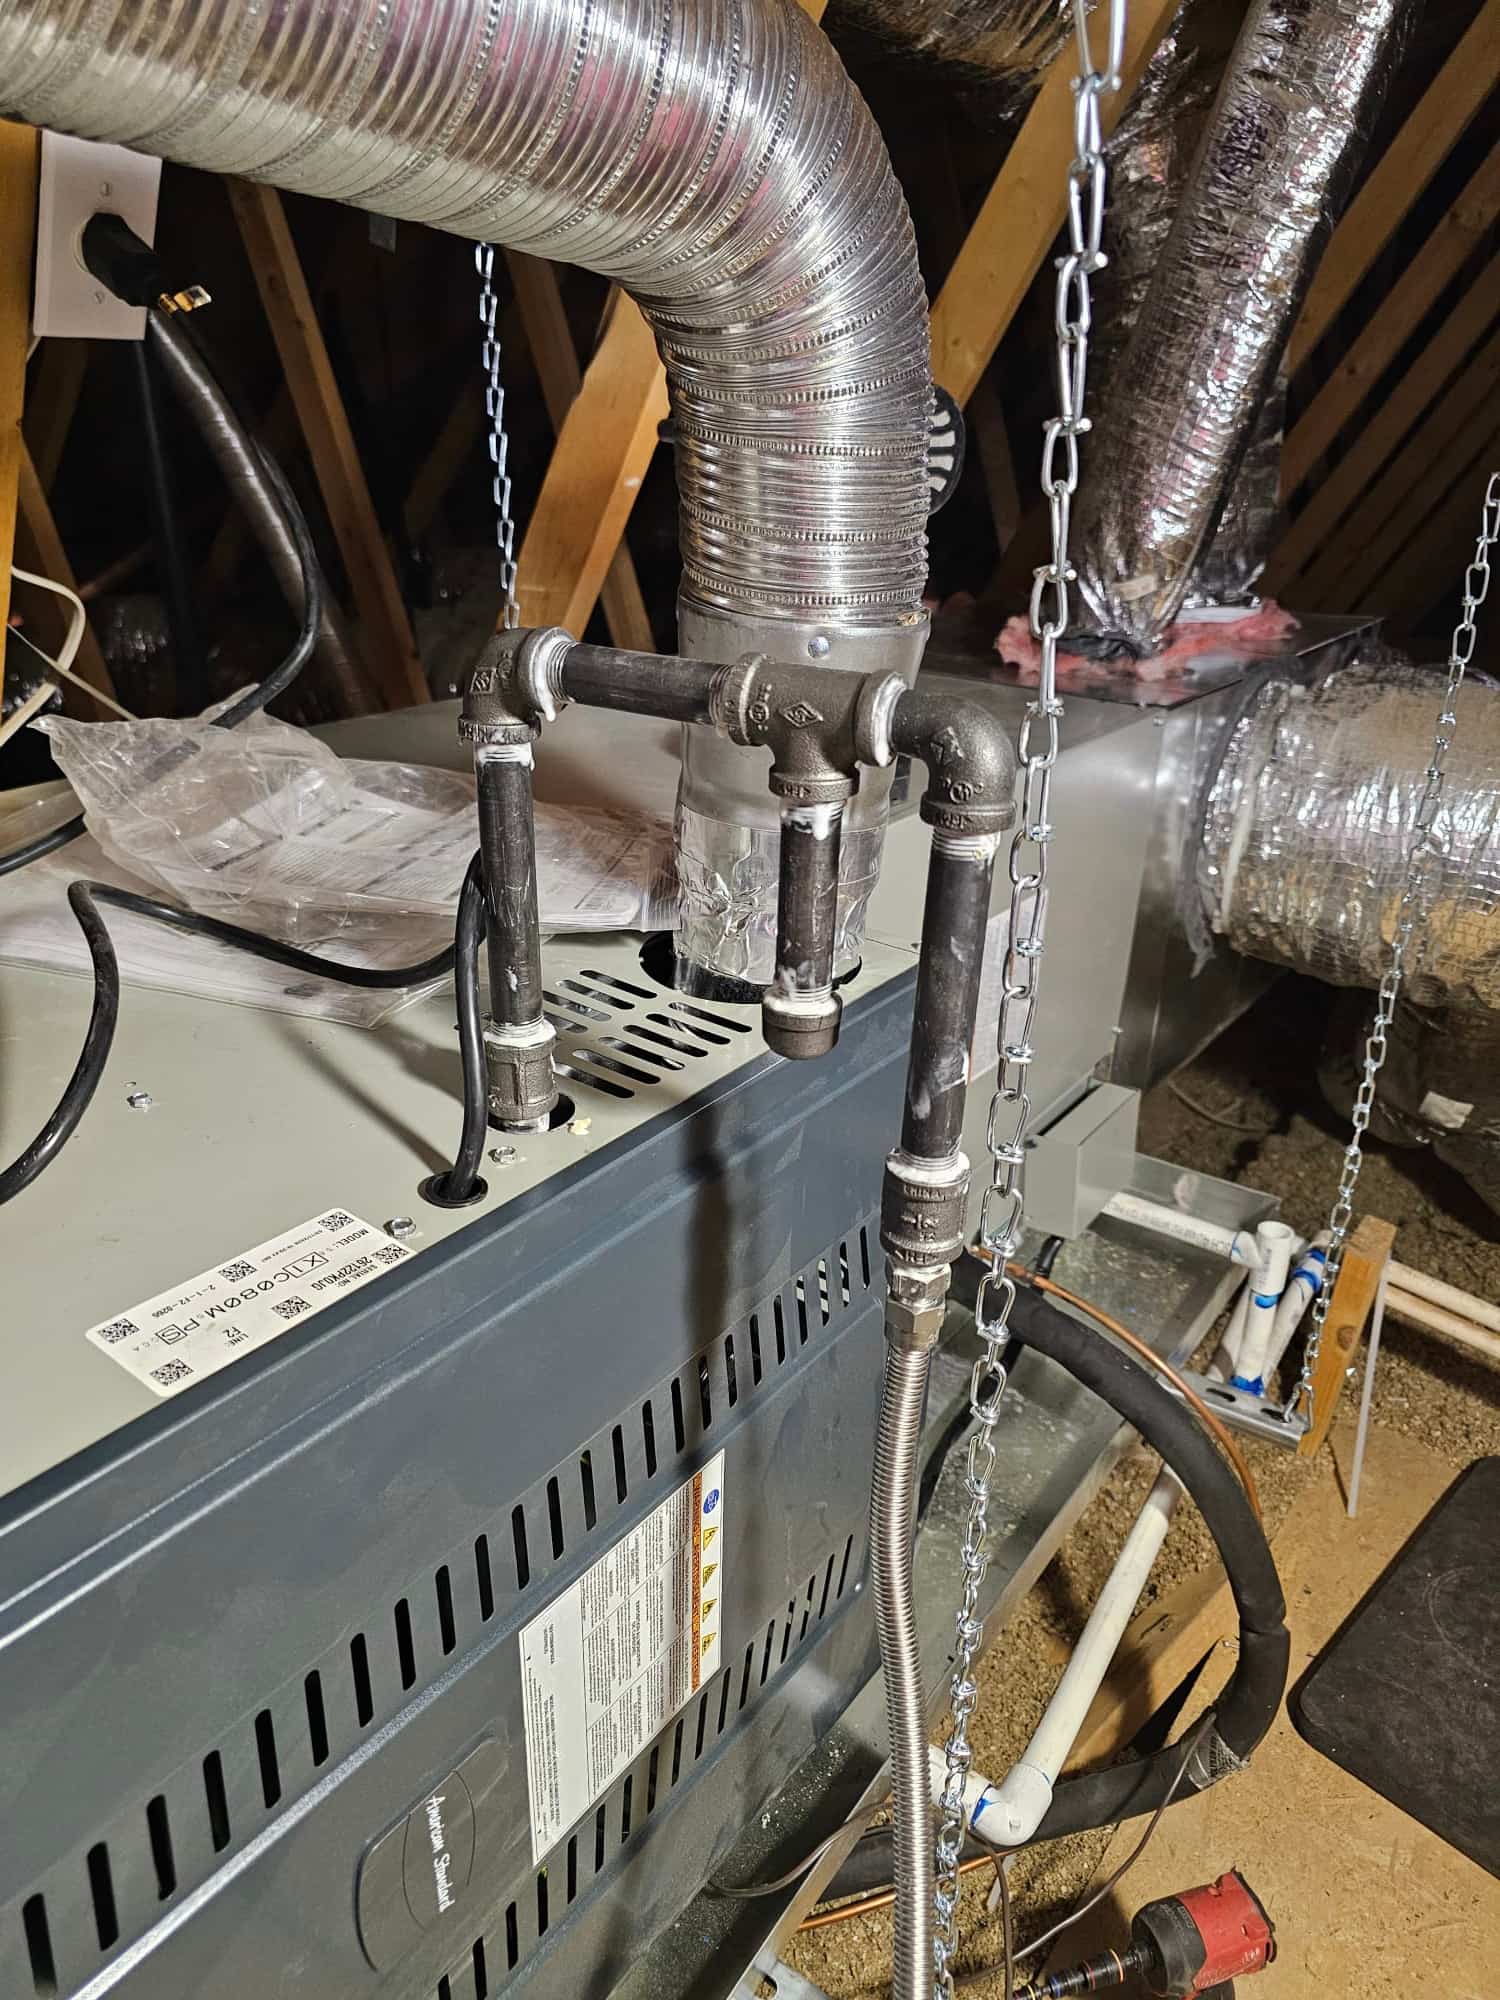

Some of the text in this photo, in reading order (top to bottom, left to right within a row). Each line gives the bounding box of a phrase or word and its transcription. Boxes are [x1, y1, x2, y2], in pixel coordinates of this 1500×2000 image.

[332, 1228, 369, 1248] MODEL:
[220, 1325, 242, 1339] F2
[425, 1795, 456, 1913] American Standard
